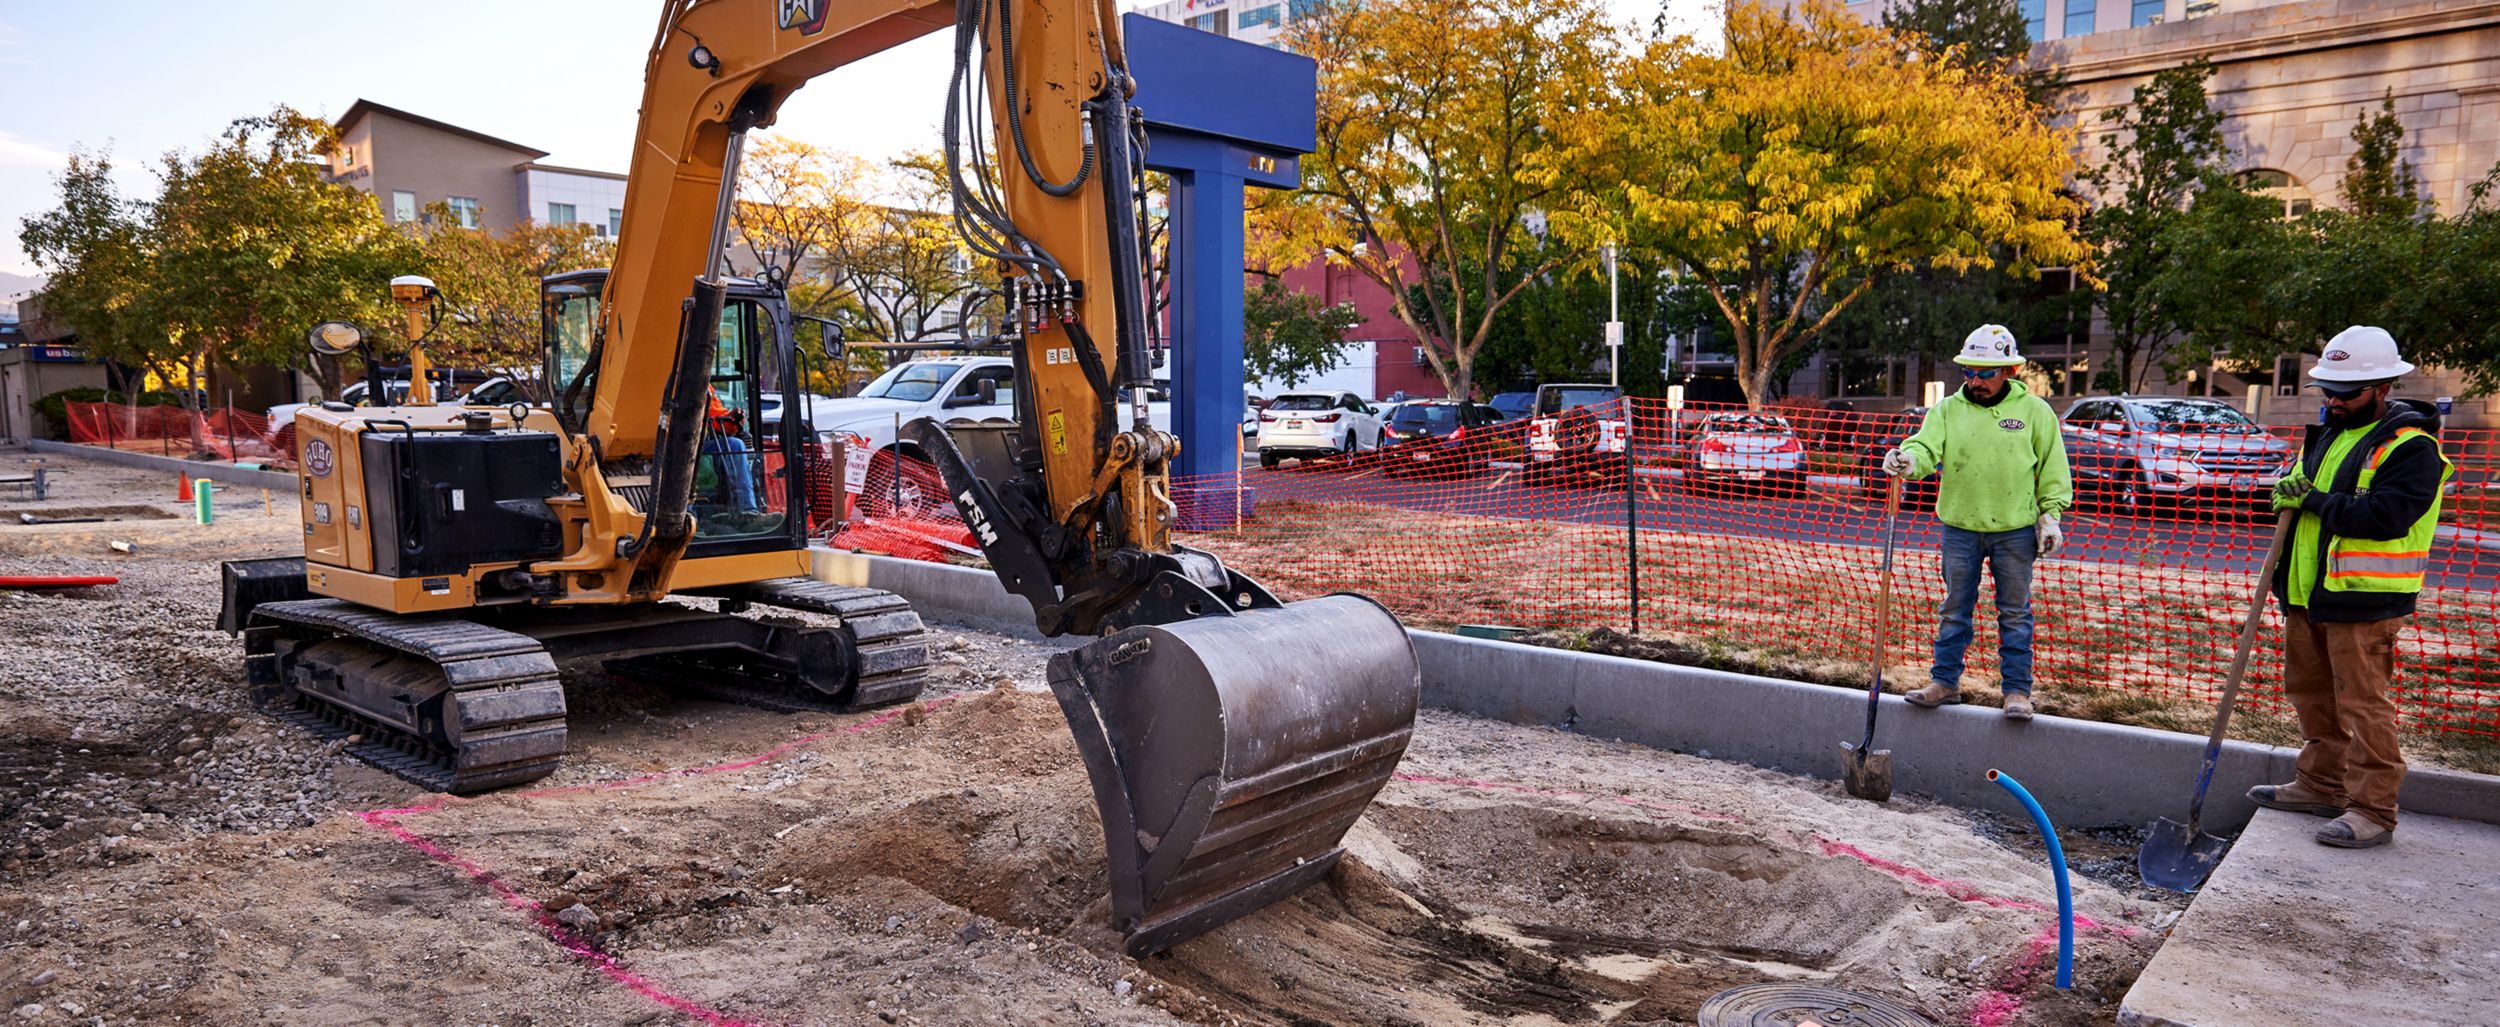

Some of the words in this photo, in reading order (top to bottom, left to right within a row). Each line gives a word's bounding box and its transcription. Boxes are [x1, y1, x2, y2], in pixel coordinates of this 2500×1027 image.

[779, 0, 814, 29] CAT
[1248, 154, 1275, 174] ATM
[2000, 419, 2024, 429] GUHO
[305, 441, 333, 468] GUHO
[855, 453, 865, 462] NO
[314, 503, 328, 524] 309
